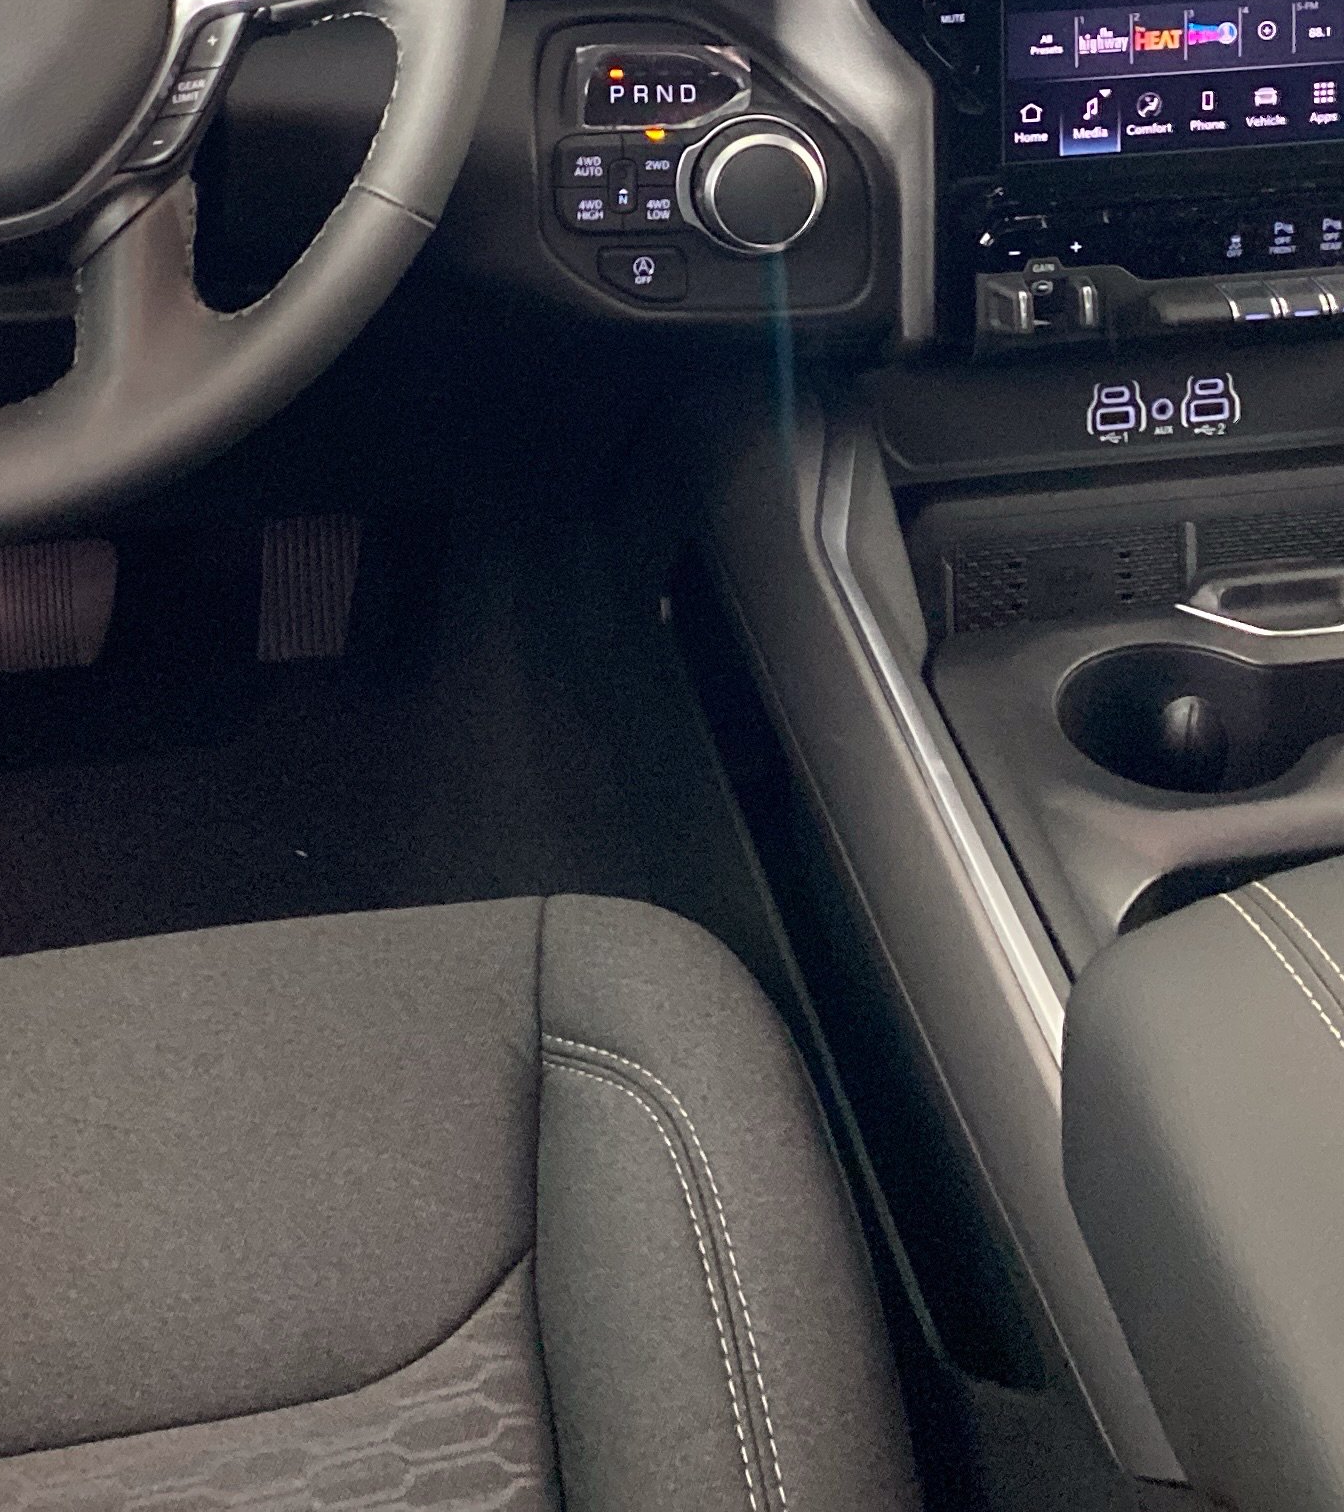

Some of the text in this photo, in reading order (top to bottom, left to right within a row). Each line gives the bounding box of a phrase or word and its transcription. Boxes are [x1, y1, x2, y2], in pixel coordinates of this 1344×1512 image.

[940, 13, 966, 23] MUTE
[1079, 34, 1129, 54] highway
[1135, 29, 1182, 51] HEAT
[610, 84, 696, 103] P R N D
[1246, 114, 1287, 127] Vehicle
[1309, 112, 1339, 125] Apps
[1126, 123, 1173, 136] Comfort
[1190, 120, 1227, 131] Phone
[1014, 132, 1048, 143] Home
[1073, 127, 1108, 139] Media
[576, 156, 601, 167] 4WD
[645, 160, 670, 171] 2WD
[574, 166, 603, 177] AUTO
[578, 199, 602, 210] 4WD
[619, 194, 627, 204] N
[646, 199, 670, 210] 4WD
[577, 209, 604, 220] HIGH
[646, 209, 670, 220] LOW
[635, 275, 652, 284] OFF
[1218, 423, 1226, 435] 2
[1123, 432, 1129, 443] 1
